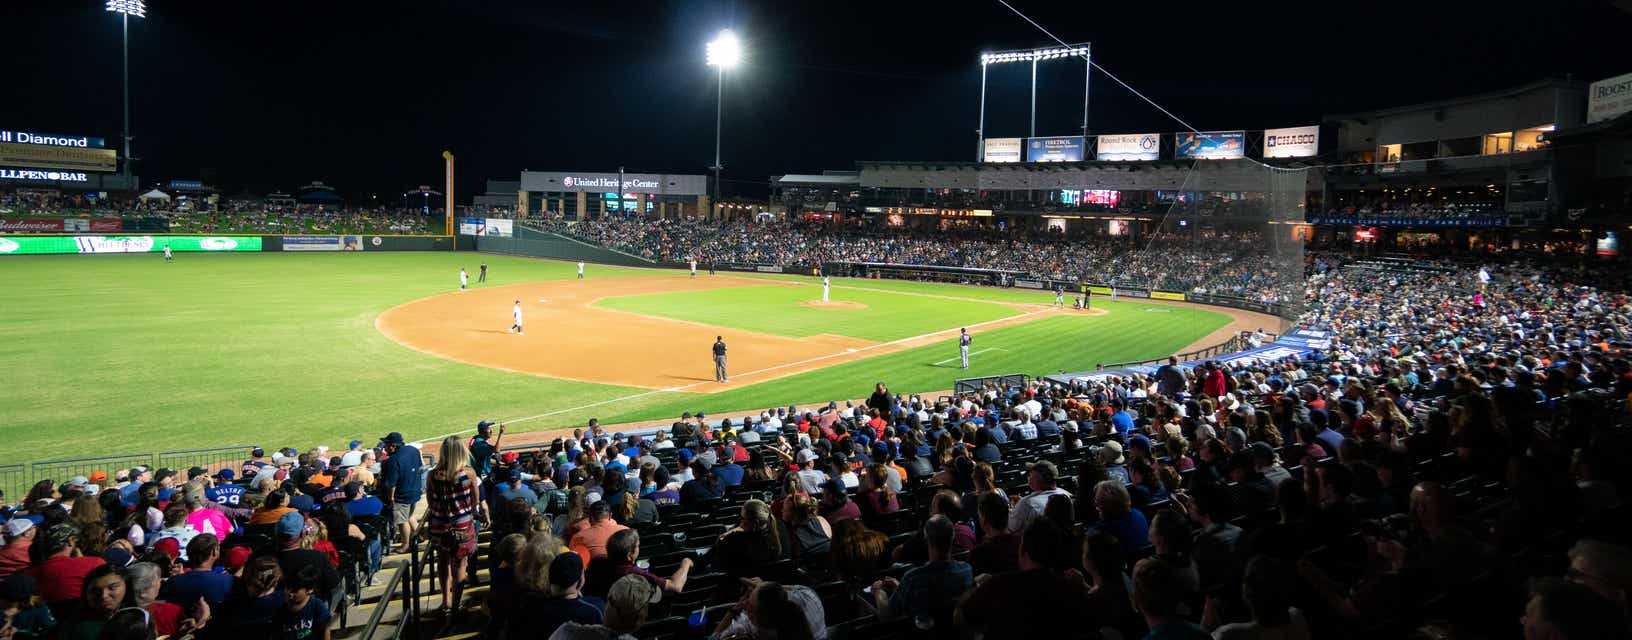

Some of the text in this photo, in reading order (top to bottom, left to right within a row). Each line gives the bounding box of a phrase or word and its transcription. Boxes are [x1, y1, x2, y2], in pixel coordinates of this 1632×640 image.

[0, 131, 87, 147] ll Diamond
[1277, 135, 1314, 145] CHASCO
[60, 172, 87, 182] BAR
[574, 178, 659, 189] United Heritge Center
[216, 495, 240, 505] 29
